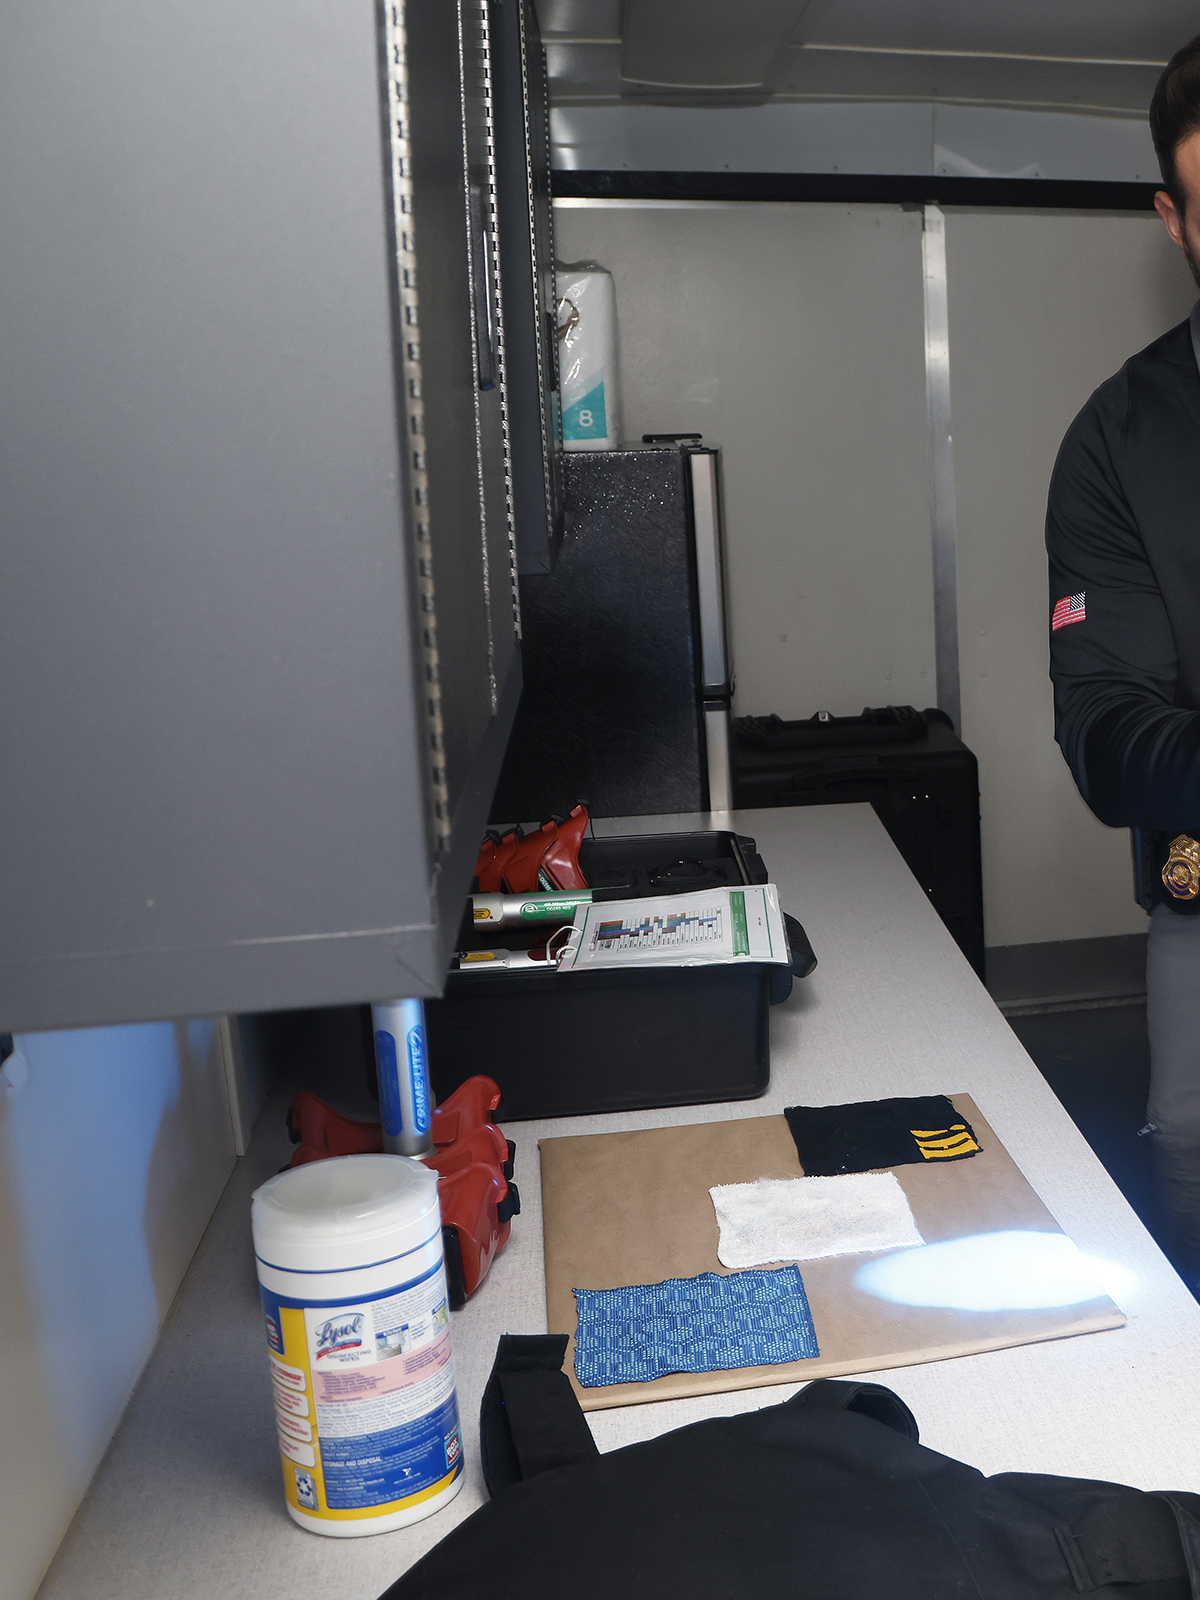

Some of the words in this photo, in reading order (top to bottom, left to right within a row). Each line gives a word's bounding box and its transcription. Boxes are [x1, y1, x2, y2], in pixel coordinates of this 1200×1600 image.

[579, 409, 594, 427] 8
[411, 1046, 428, 1129] CRIME-LITE
[315, 1315, 361, 1347] Lysol
[326, 1349, 371, 1359] DISINFECTING
